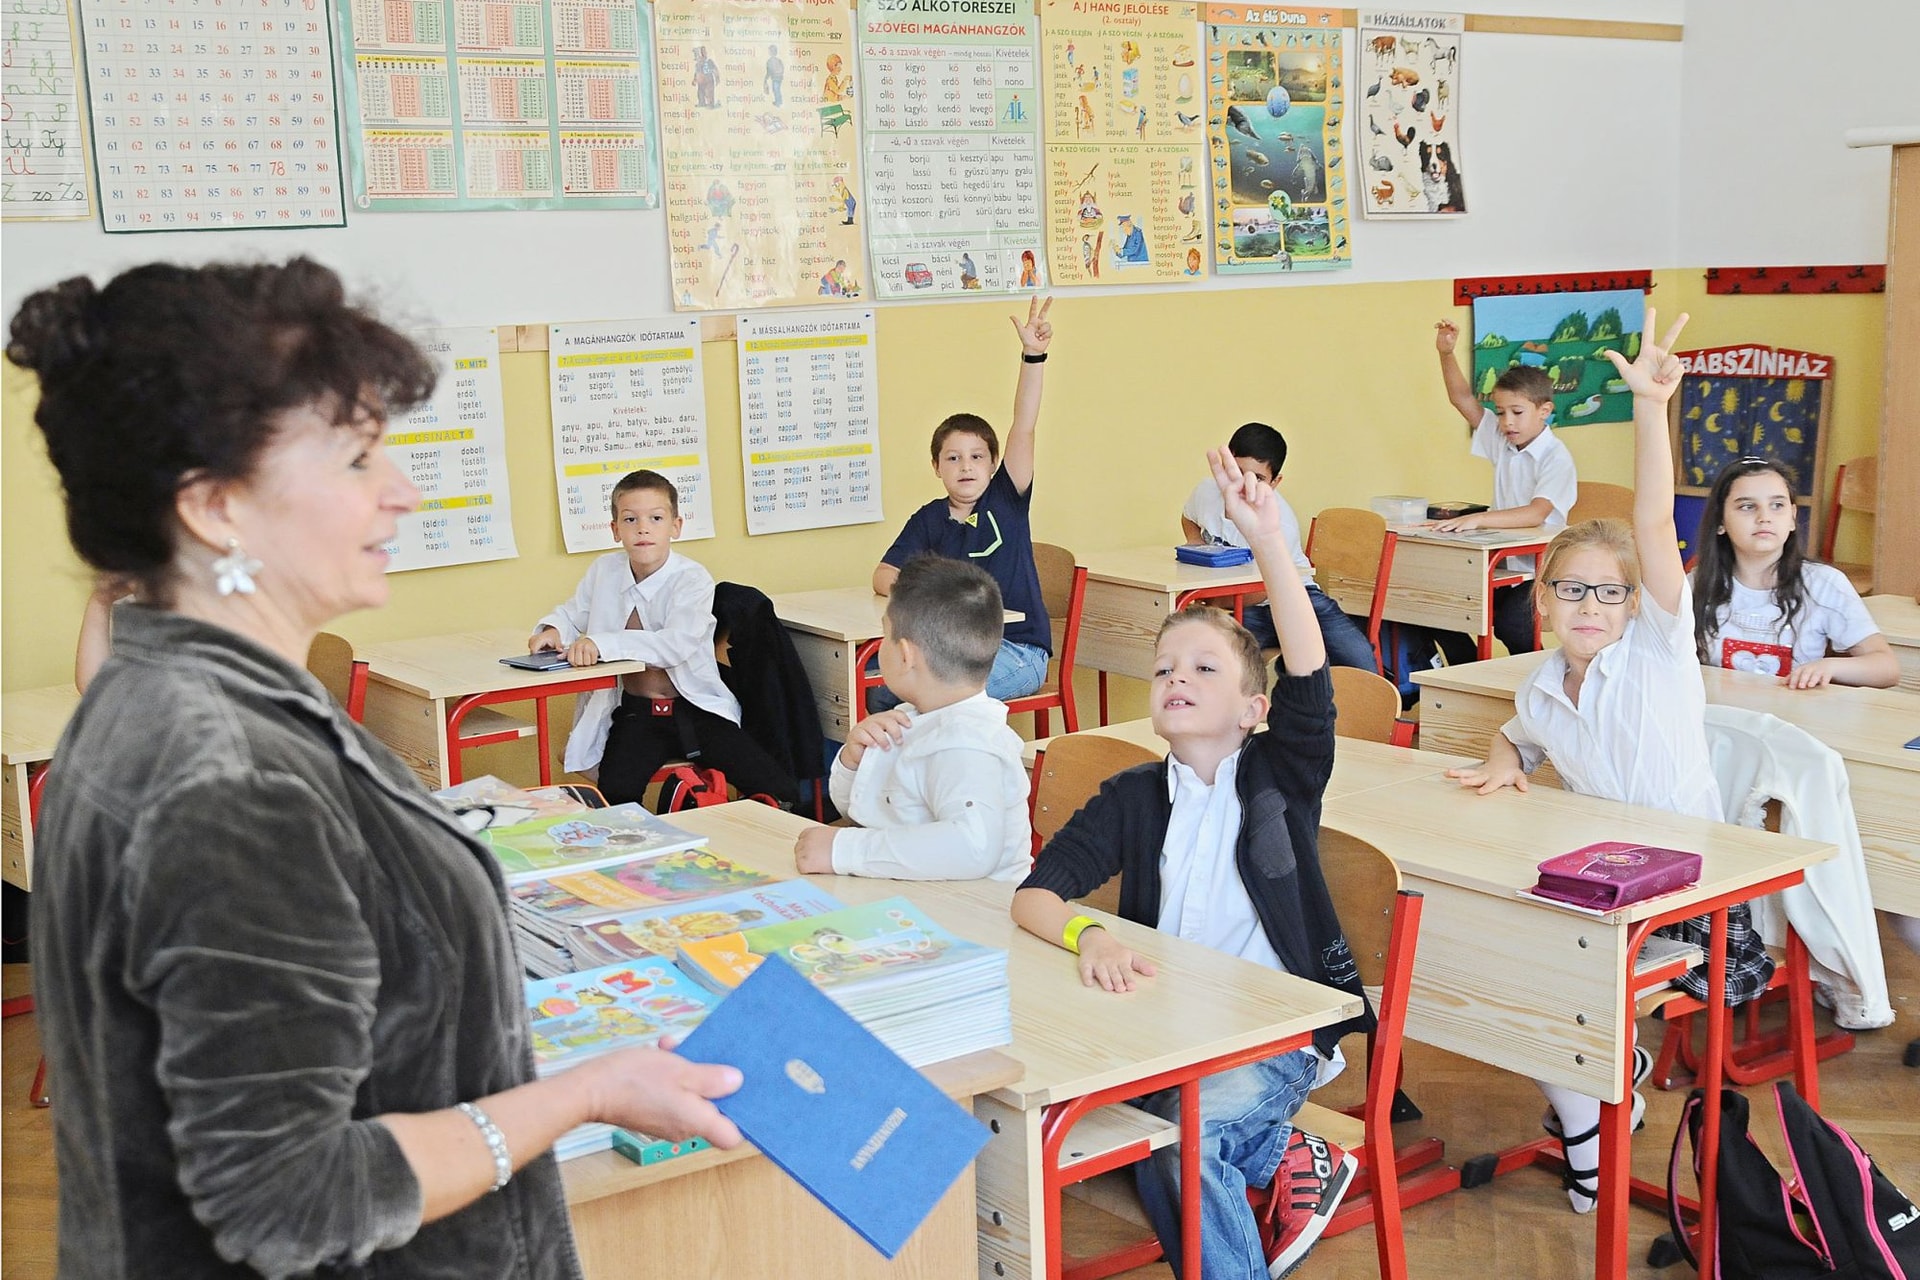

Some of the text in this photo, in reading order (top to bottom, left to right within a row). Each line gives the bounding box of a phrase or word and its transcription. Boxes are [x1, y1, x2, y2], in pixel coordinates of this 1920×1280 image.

[1074, 2, 1168, 15] A J HANG JELÖLÉSE
[1245, 9, 1261, 23] Az
[1280, 10, 1307, 24] Duna
[1374, 13, 1445, 28] HÁZIÁLLATOK
[868, 20, 1025, 35] SZÓVÉGI MAGÁNHANGZÓK
[996, 49, 1029, 58] Kivételek
[101, 68, 321, 79] 31 32 33 34 35 36 37 38 39 40
[105, 117, 324, 126] 51 52 53 54 55 56 57 58 59 60
[110, 166, 120, 174] 71
[134, 166, 146, 174] 72
[158, 165, 170, 174] 73
[182, 165, 193, 173] 74
[206, 165, 217, 173] 75
[228, 164, 239, 172] 76
[250, 164, 260, 172] 77
[270, 161, 285, 176] 78
[317, 164, 328, 172] 80
[116, 209, 335, 223] 91 92 93 94 95 96 97 98 99 100
[759, 324, 817, 334] MÁSSALHANGZÓK
[574, 334, 636, 344] MAGÁNHANGZÓK
